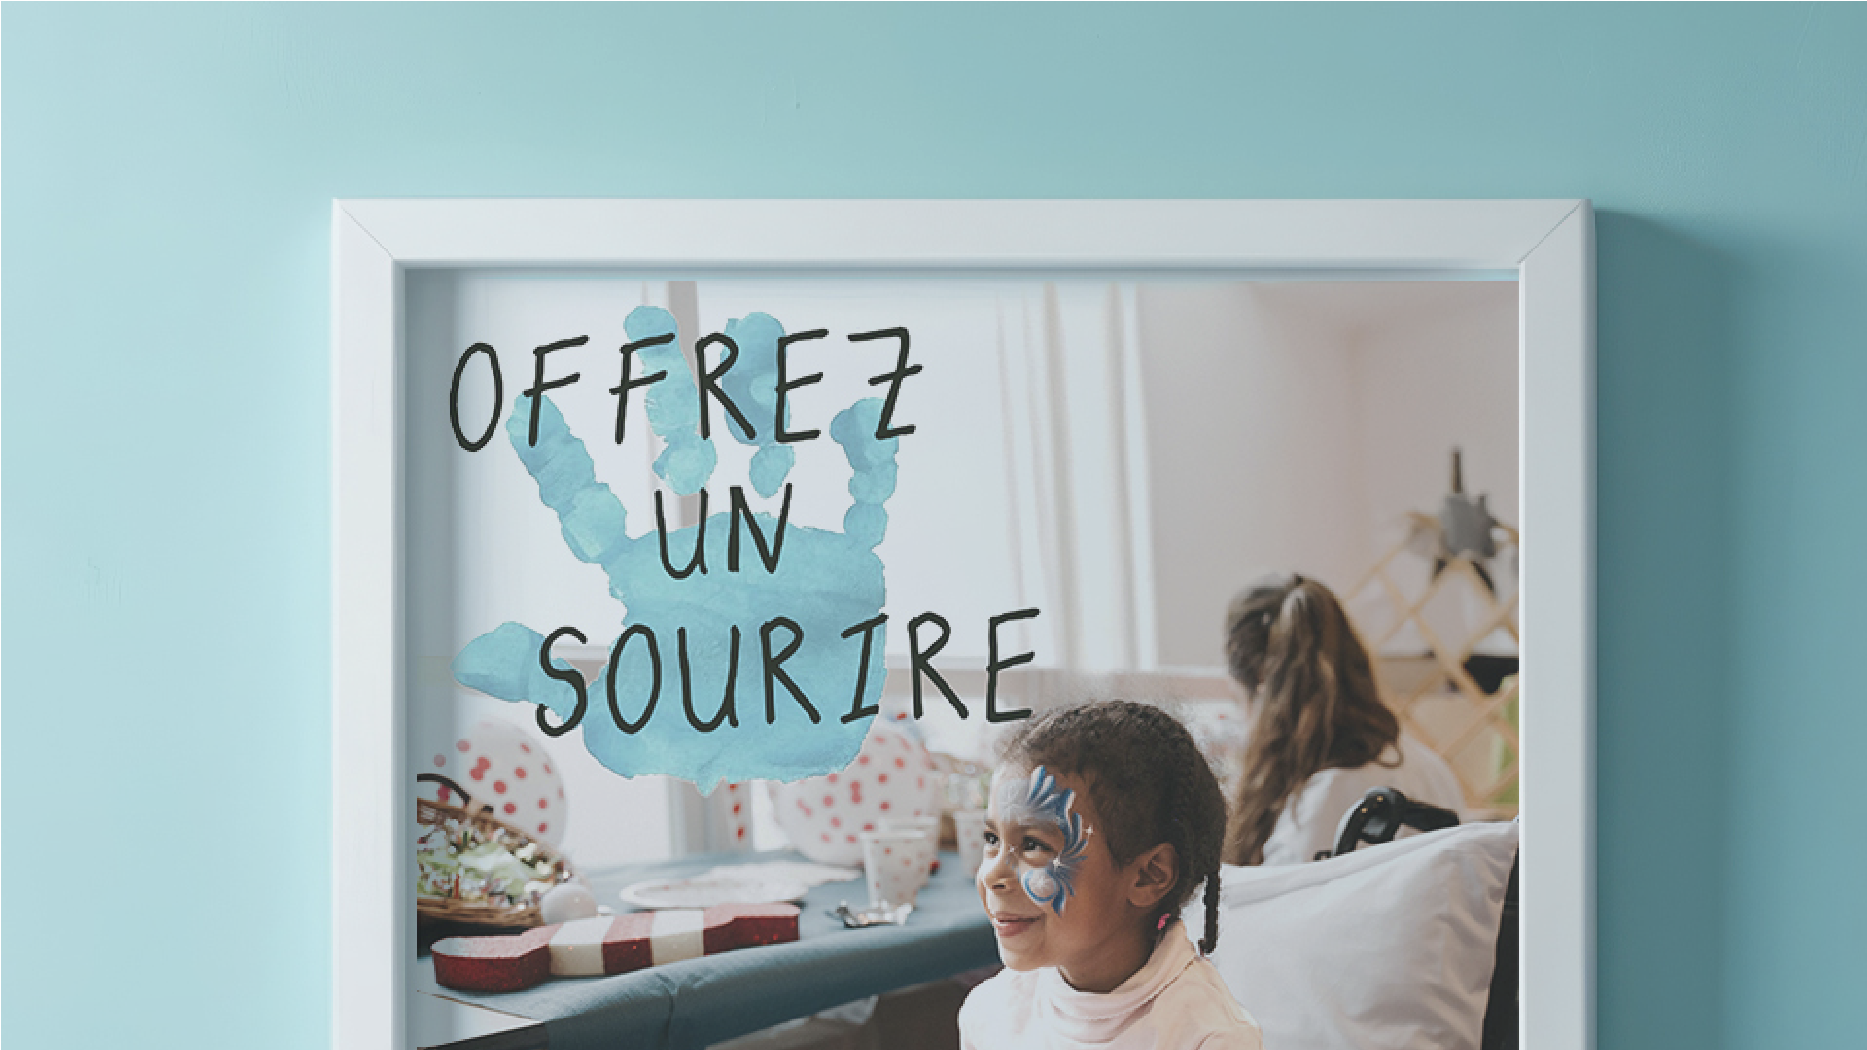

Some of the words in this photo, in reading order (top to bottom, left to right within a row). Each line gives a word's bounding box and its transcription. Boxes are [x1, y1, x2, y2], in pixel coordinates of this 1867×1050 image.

[449, 326, 923, 453] OFFREZ
[653, 482, 793, 581] UN
[535, 607, 1040, 738] SOURIRE
